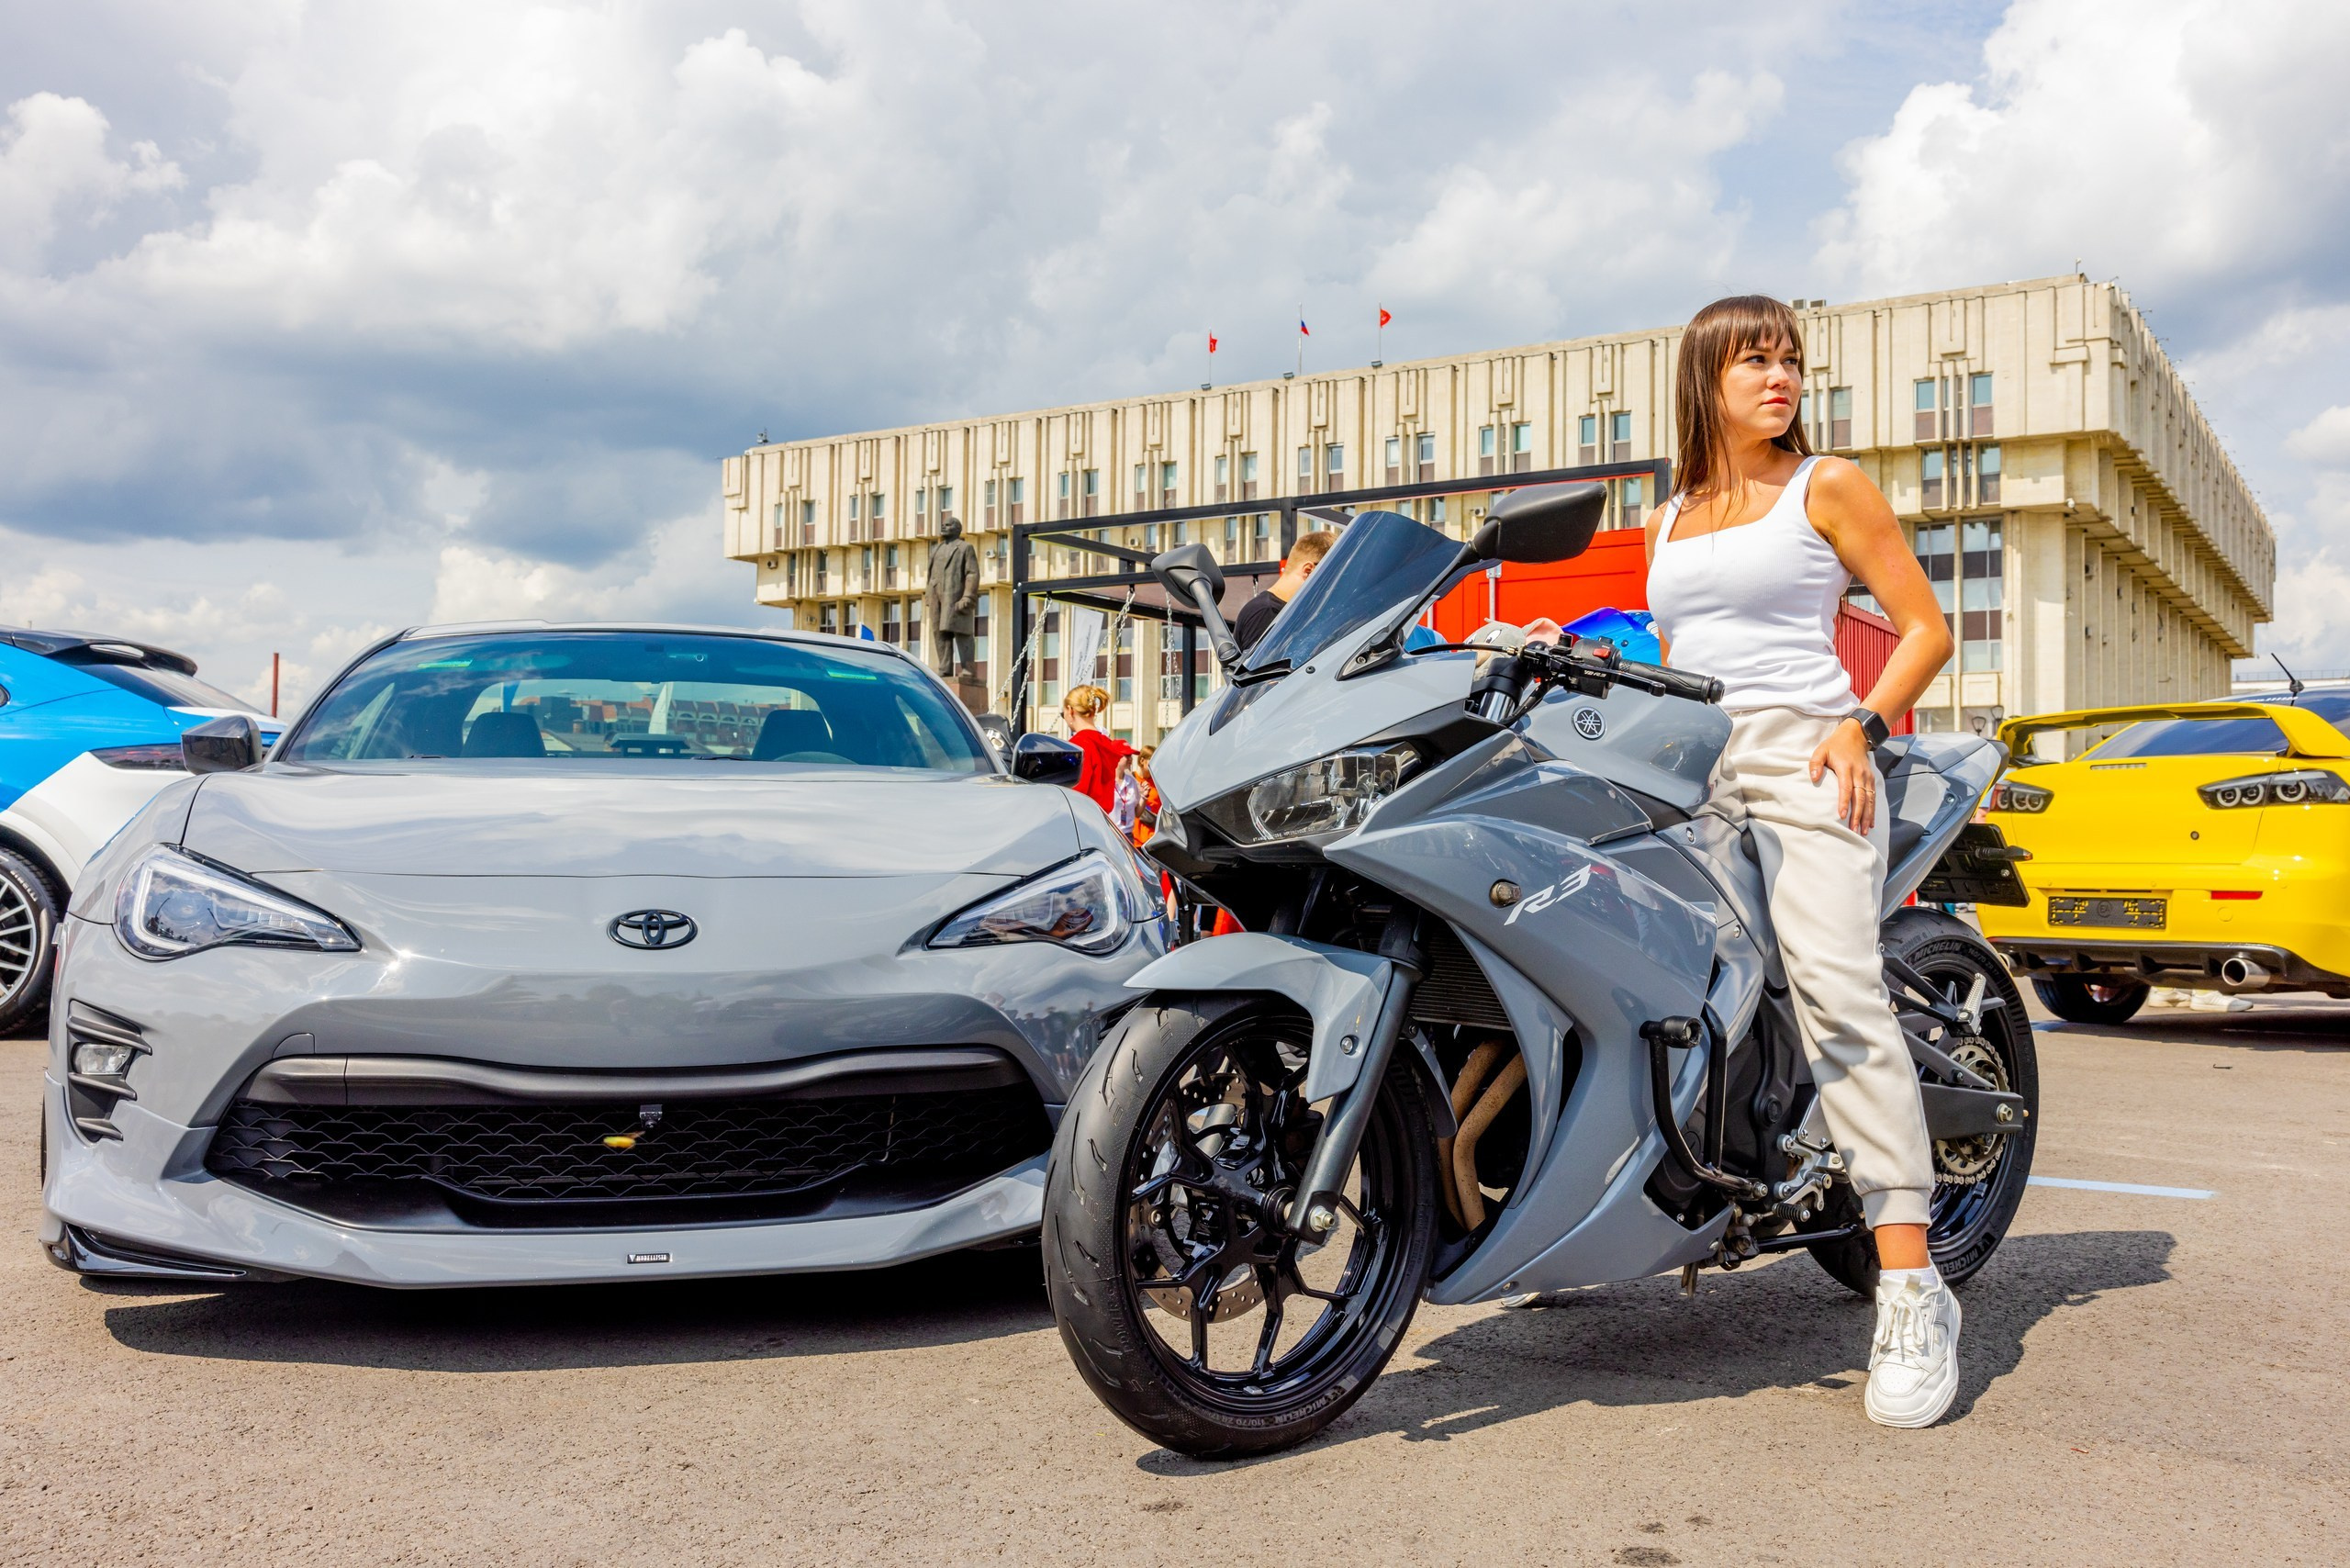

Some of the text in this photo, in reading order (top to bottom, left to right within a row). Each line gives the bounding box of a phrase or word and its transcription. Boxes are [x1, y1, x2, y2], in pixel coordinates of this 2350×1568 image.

[1504, 864, 1592, 926] R3
[1914, 941, 1963, 961] MICHELIN
[1274, 1395, 1327, 1423] MICHELIN
[1235, 1417, 1266, 1427] 110/70
